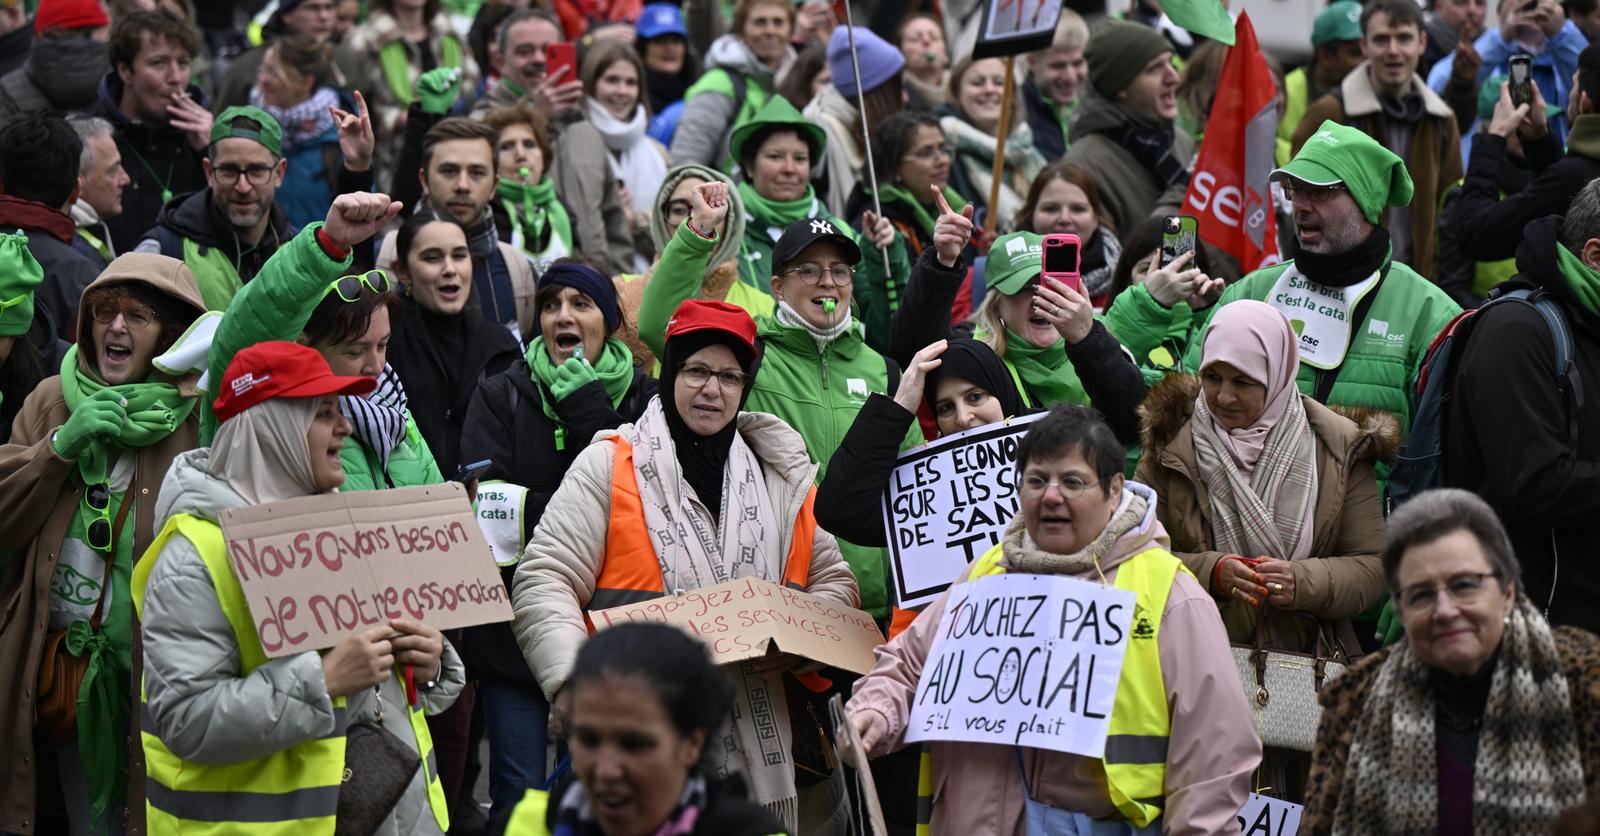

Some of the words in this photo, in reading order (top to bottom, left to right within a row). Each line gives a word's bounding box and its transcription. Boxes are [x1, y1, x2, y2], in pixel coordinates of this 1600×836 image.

[1276, 293, 1302, 307] c'est
[1304, 297, 1316, 311] la
[1289, 277, 1317, 293] Sans
[1320, 285, 1346, 304] bras,
[896, 456, 941, 493] LES
[952, 435, 1025, 474] ECONO
[893, 489, 937, 524] SUR
[950, 472, 991, 507] LES
[230, 532, 312, 582] Nous
[392, 521, 468, 554] besoin
[901, 522, 934, 549] DE
[742, 579, 772, 599] du
[259, 596, 308, 653] de
[309, 586, 402, 634] notre
[403, 578, 508, 620] association
[946, 594, 1048, 640] TOUCHEZ
[1059, 599, 1123, 645] PAS
[920, 650, 964, 706] AU
[923, 708, 951, 732] s'il
[965, 716, 1007, 734] vous
[1016, 714, 1065, 744] plait
